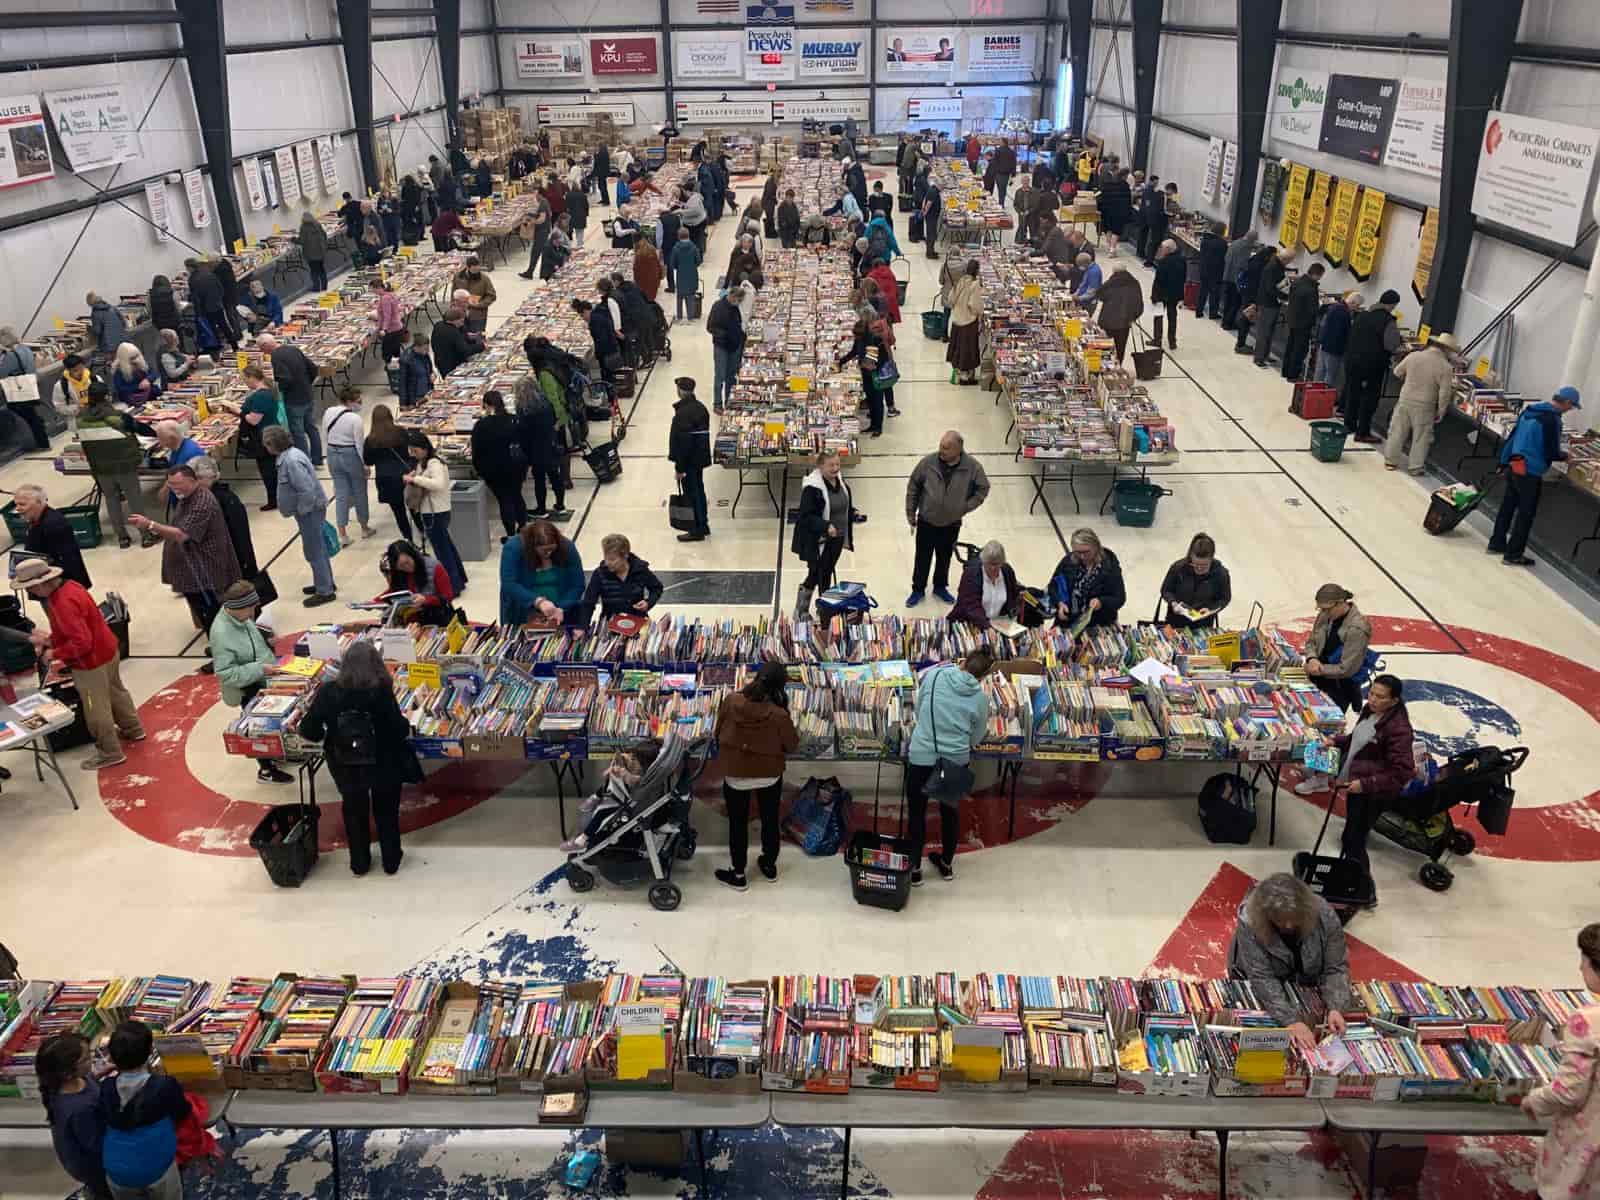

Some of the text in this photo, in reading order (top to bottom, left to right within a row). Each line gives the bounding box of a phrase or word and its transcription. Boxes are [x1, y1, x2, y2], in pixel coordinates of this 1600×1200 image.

[748, 29, 792, 40] Peace Arch
[984, 36, 1021, 44] BARNES
[748, 38, 792, 51] news
[802, 42, 862, 55] MURRAY
[600, 53, 621, 63] KPU
[815, 59, 857, 67] HYUNDAI
[1337, 98, 1382, 119] Game-Changing
[1335, 115, 1377, 134] Business Advice
[1552, 137, 1593, 156] CABINETS
[620, 1007, 660, 1016] CHILDREN
